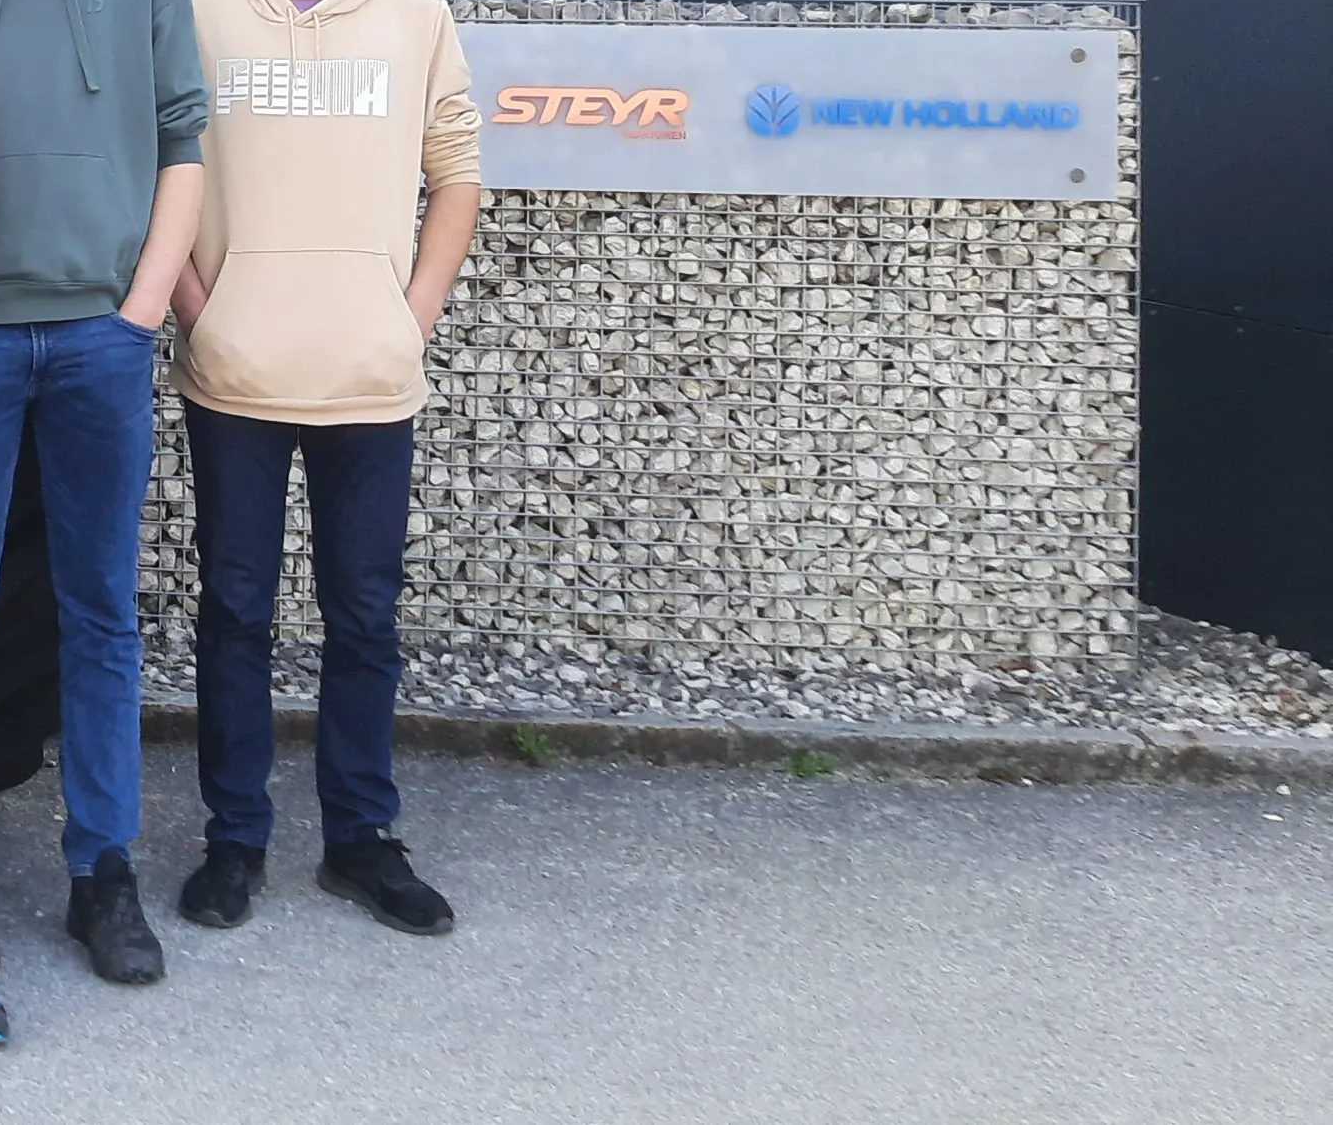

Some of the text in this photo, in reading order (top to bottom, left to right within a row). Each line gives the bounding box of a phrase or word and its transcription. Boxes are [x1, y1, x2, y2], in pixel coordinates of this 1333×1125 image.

[216, 59, 389, 117] PUMA
[491, 86, 690, 127] STEYR
[812, 98, 1080, 130] NEW HOLLAND
